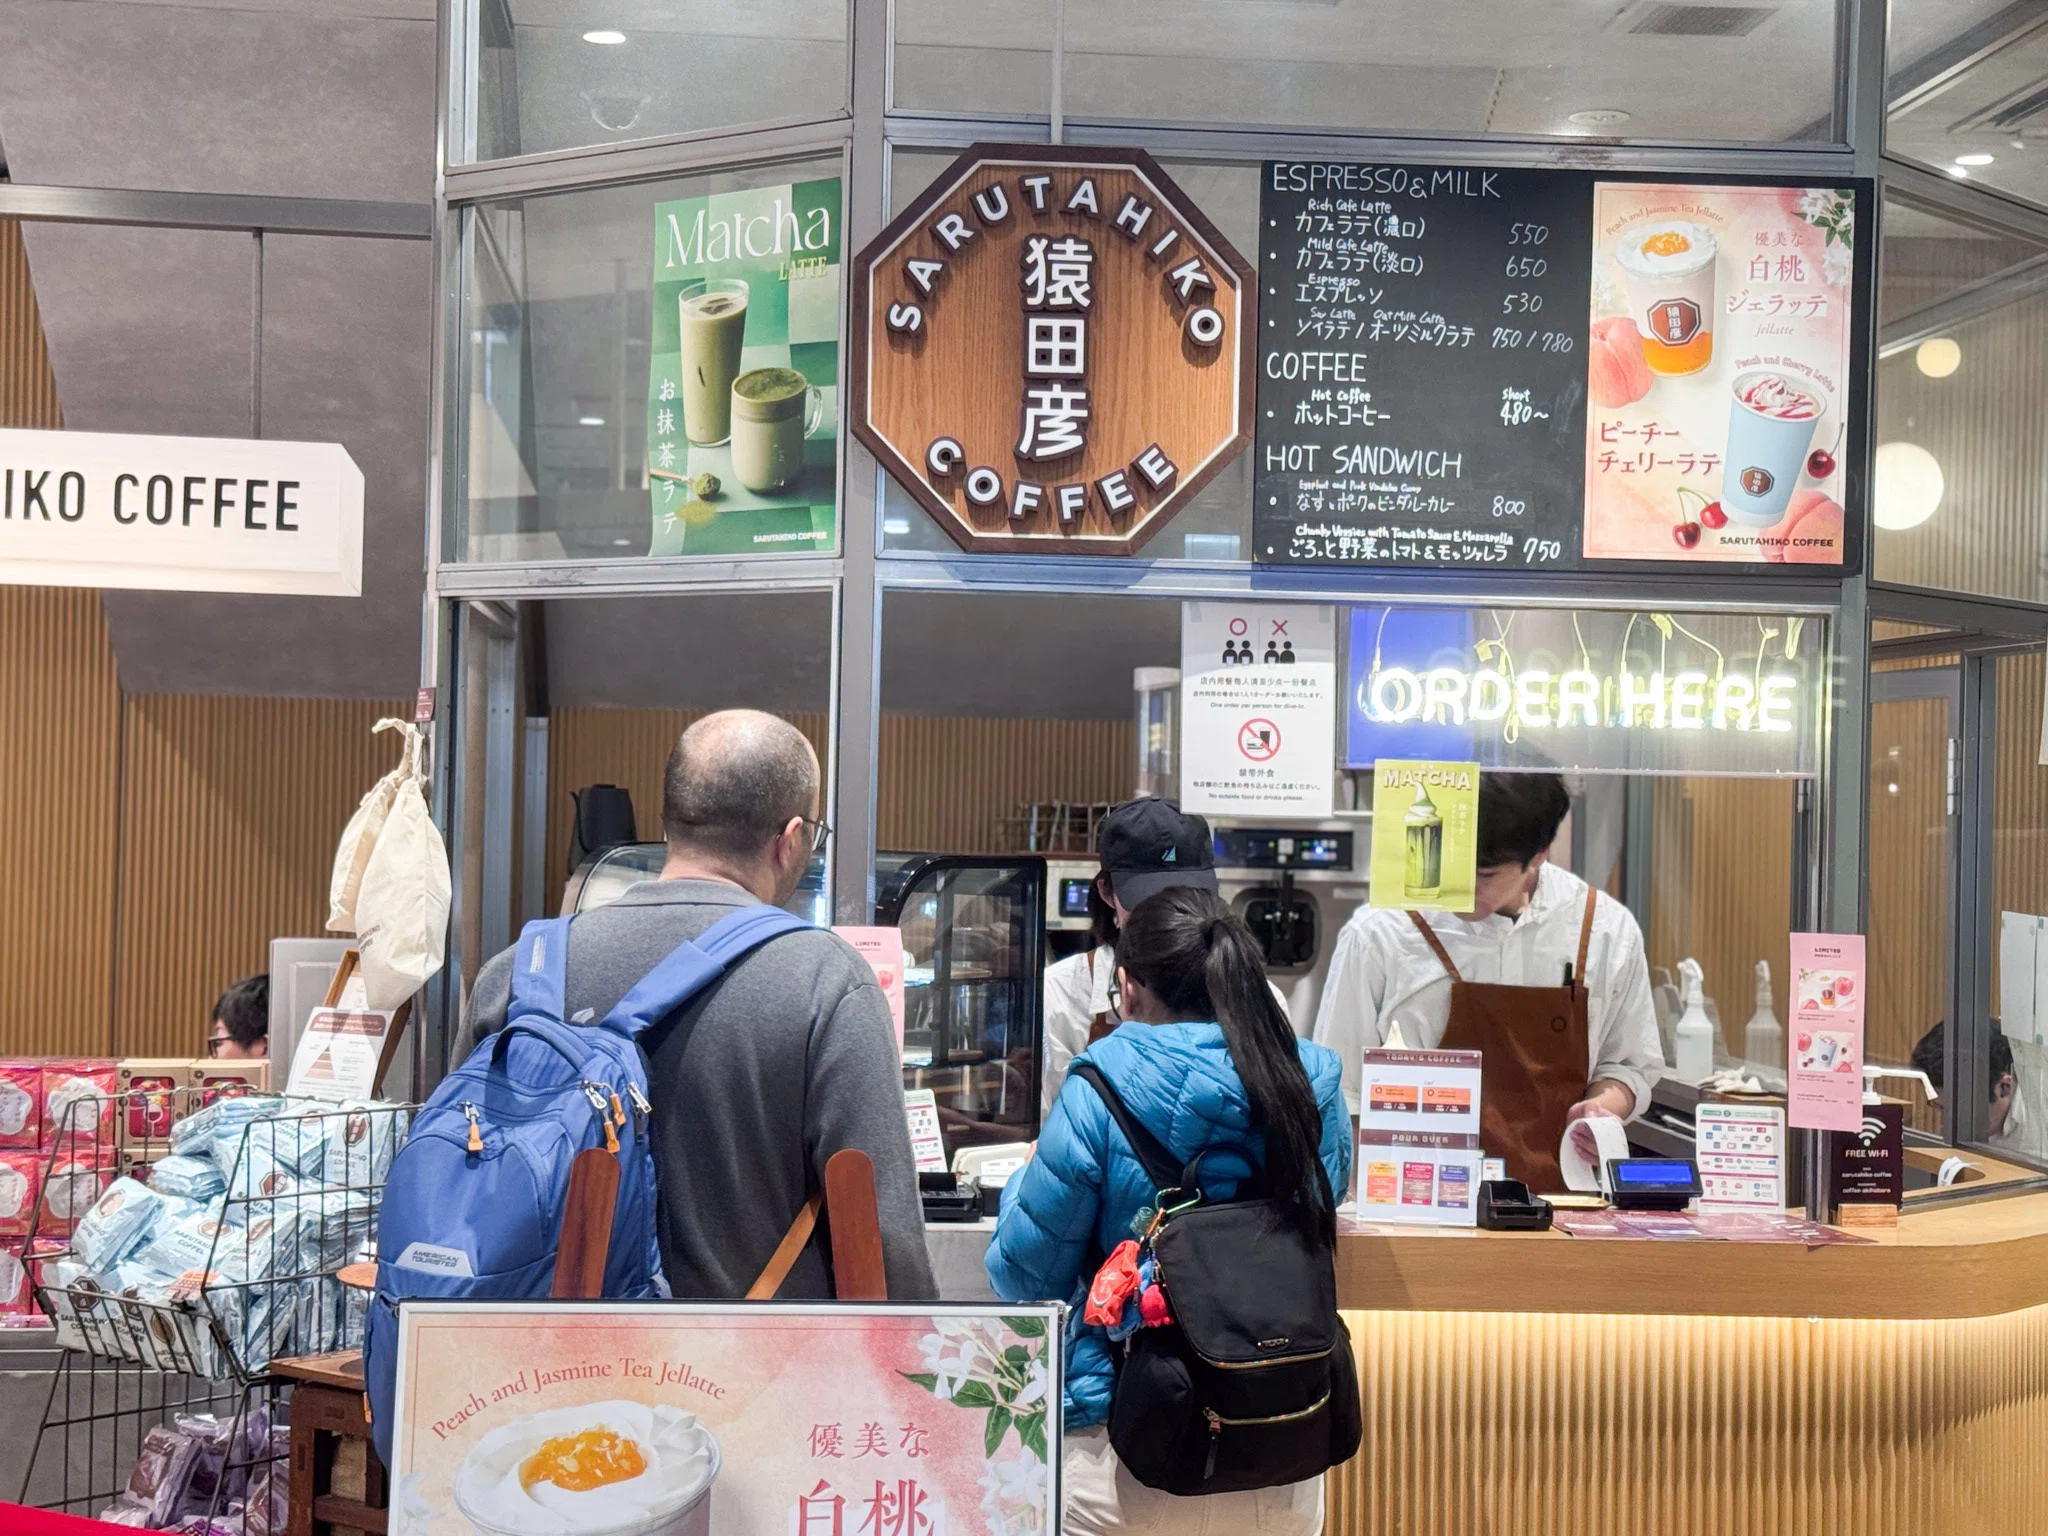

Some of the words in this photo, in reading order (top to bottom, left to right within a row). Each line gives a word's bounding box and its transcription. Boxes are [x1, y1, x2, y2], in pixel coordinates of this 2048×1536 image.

[1308, 198, 1333, 212] Rich
[1337, 199, 1357, 213] Cafe
[1361, 199, 1392, 214] Latte
[1295, 211, 1426, 239] カフェラテ(濃口)
[1606, 216, 1628, 236] Peach
[1629, 208, 1644, 221] and
[1645, 204, 1678, 218] Jasmine
[1680, 204, 1694, 213] Tea
[1695, 204, 1724, 223] Jellatte
[665, 200, 829, 268] Matcha
[1308, 237, 1333, 250] Mild
[1336, 238, 1357, 251] Cafe
[1360, 239, 1389, 254] Latte
[1508, 222, 1549, 245] 550
[1754, 231, 1805, 248] 優美な
[778, 256, 828, 282] LATTE
[888, 175, 1224, 343] SARUTAHIKO
[1296, 247, 1424, 276] カフェラテ(淡口)
[1505, 255, 1547, 277] 650
[1749, 253, 1806, 282] 白桃
[1308, 273, 1360, 287] Espresso
[1295, 284, 1383, 305] エスプレッソ
[1502, 293, 1543, 314] 530
[1727, 288, 1827, 318] ジェラッテ
[1330, 308, 1356, 321] Latte
[1419, 311, 1446, 325] Latte
[1754, 323, 1795, 338] jellatte
[1019, 237, 1093, 458] 猿田彦
[1266, 352, 1367, 383] COFFEE
[1311, 389, 1332, 402] Hot
[1337, 388, 1371, 404] Coffee
[1294, 402, 1391, 426] ホットコーヒー
[1600, 420, 1680, 445] ピーチー
[656, 377, 678, 536] お抹茶ラテ
[1266, 445, 1320, 473] HOT
[1332, 445, 1462, 479] SANDWICH
[1597, 451, 1721, 476] チェリーラテ
[929, 446, 1174, 520] COFFEE
[113, 472, 300, 532] COFFEE
[1492, 495, 1526, 517] 800
[1523, 537, 1561, 563] 750
[1720, 536, 1790, 547] SARUTAHIKO
[1792, 538, 1834, 547] COFFEE
[1366, 666, 1600, 728] ORDER
[1620, 671, 1797, 732] HERE
[1384, 769, 1472, 791] MATCHA
[1391, 1134, 1418, 1142] POUR
[1845, 1149, 1866, 1158] FREE
[412, 1256, 457, 1268] TOURISTER
[413, 1250, 460, 1263] AMERICAN
[432, 1393, 487, 1440] Peach
[491, 1371, 528, 1402] and
[534, 1361, 612, 1394] Jasmine
[619, 1357, 653, 1378] Tea
[656, 1361, 726, 1400] Jellatte
[806, 1421, 929, 1459] 優美な
[796, 1478, 936, 1536] 白桃
